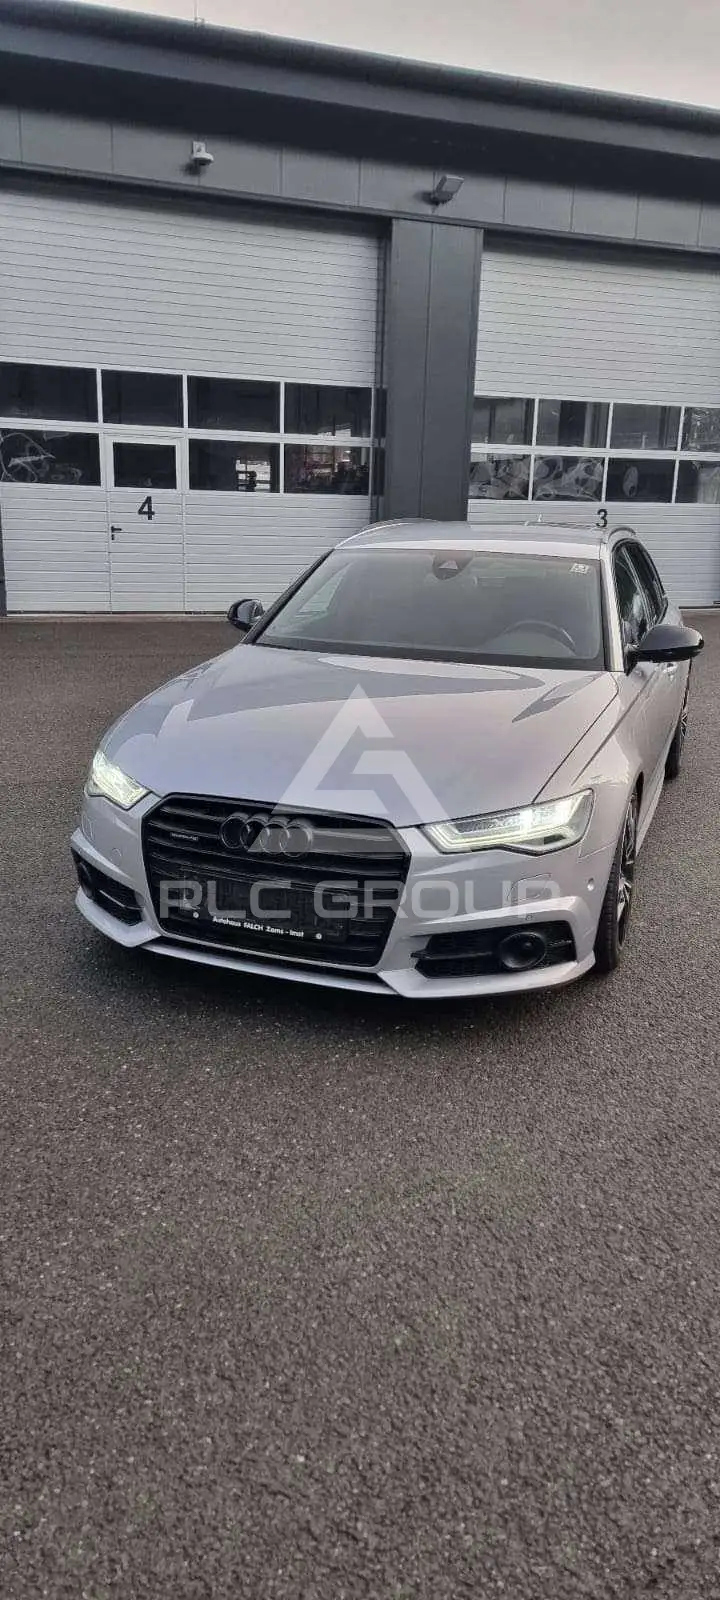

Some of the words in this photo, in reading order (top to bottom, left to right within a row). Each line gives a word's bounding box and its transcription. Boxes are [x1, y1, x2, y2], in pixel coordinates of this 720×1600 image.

[138, 496, 156, 520] 4
[596, 509, 608, 528] 3
[212, 915, 241, 927] Autohaus
[243, 922, 264, 931] FALCH
